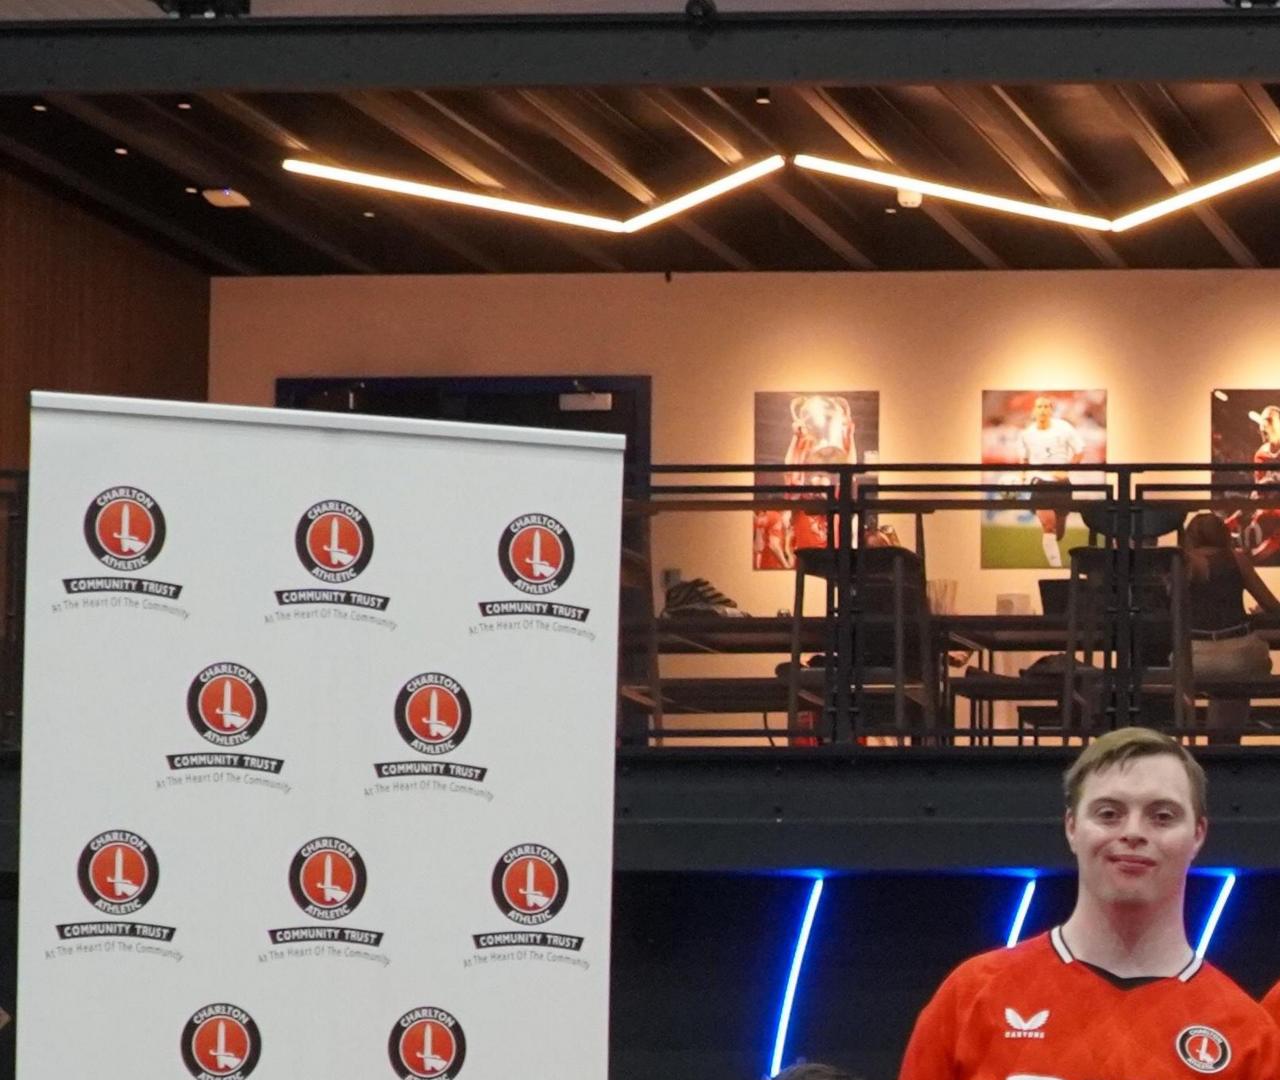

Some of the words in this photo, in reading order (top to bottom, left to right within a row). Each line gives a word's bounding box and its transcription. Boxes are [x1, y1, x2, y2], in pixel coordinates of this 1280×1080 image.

[96, 487, 154, 508] CHARLTON
[307, 501, 363, 522] CHARLTON
[509, 514, 564, 535] CHARLTON
[101, 554, 149, 570] ATHLETIC
[311, 567, 357, 582] ATHLETIC
[70, 579, 138, 591] COMMUNITY
[142, 581, 177, 597] TRUST
[513, 579, 559, 594] ATHLETIC
[281, 591, 347, 603] COMMUNITY
[350, 593, 384, 608] TRUST
[485, 602, 549, 614] COMMUNITY
[552, 604, 585, 620] TRUST
[199, 663, 256, 684] CHARLTON
[406, 674, 461, 694] CHARLTON
[203, 730, 250, 745] ATHLETIC
[411, 739, 455, 754] ATHLETIC
[173, 755, 239, 767] COMMUNITY
[243, 756, 278, 771] TRUST
[381, 763, 446, 776] COMMUNITY
[449, 765, 482, 780] TRUST
[90, 831, 148, 852] CHARLTON
[300, 839, 356, 859] CHARLTON
[503, 845, 558, 864] CHARLTON
[94, 899, 143, 914] ATHLETIC
[305, 904, 351, 920] ATHLETIC
[507, 910, 553, 925] ATHLETIC
[63, 923, 131, 938] COMMUNITY
[135, 924, 170, 939] TRUST
[276, 928, 341, 942] COMMUNITY
[343, 930, 378, 945] TRUST
[479, 934, 542, 947] COMMUNITY
[546, 935, 579, 949] TRUST
[193, 1005, 250, 1025] CHARLTON
[400, 1008, 456, 1028] CHARLTON
